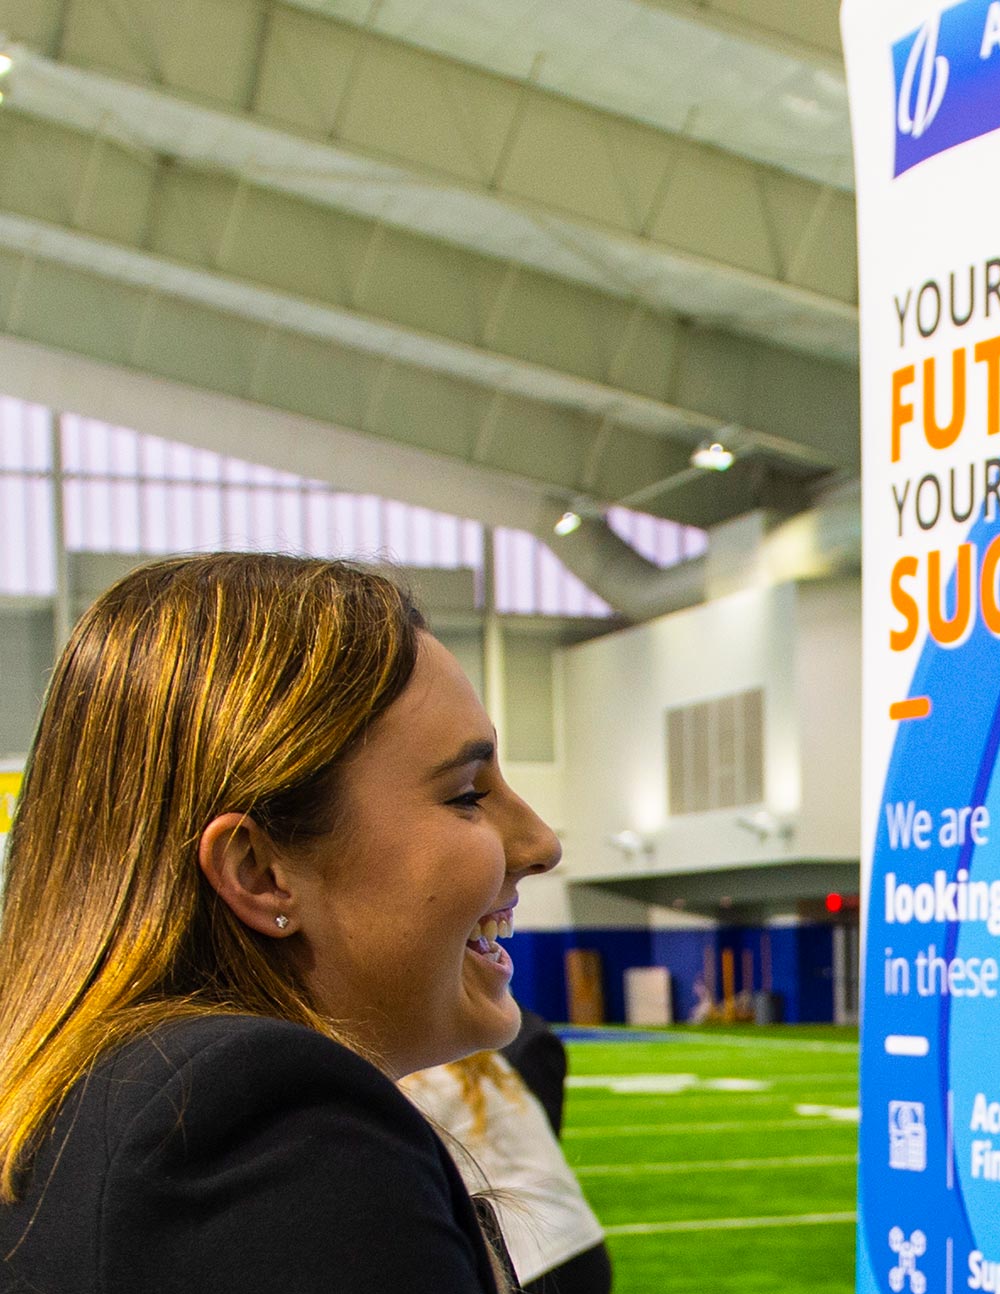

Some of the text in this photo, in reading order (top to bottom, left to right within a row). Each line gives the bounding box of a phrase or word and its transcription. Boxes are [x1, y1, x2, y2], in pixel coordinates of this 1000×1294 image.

[886, 801, 990, 850] We are
[885, 947, 910, 996] in
[915, 944, 999, 998] these
